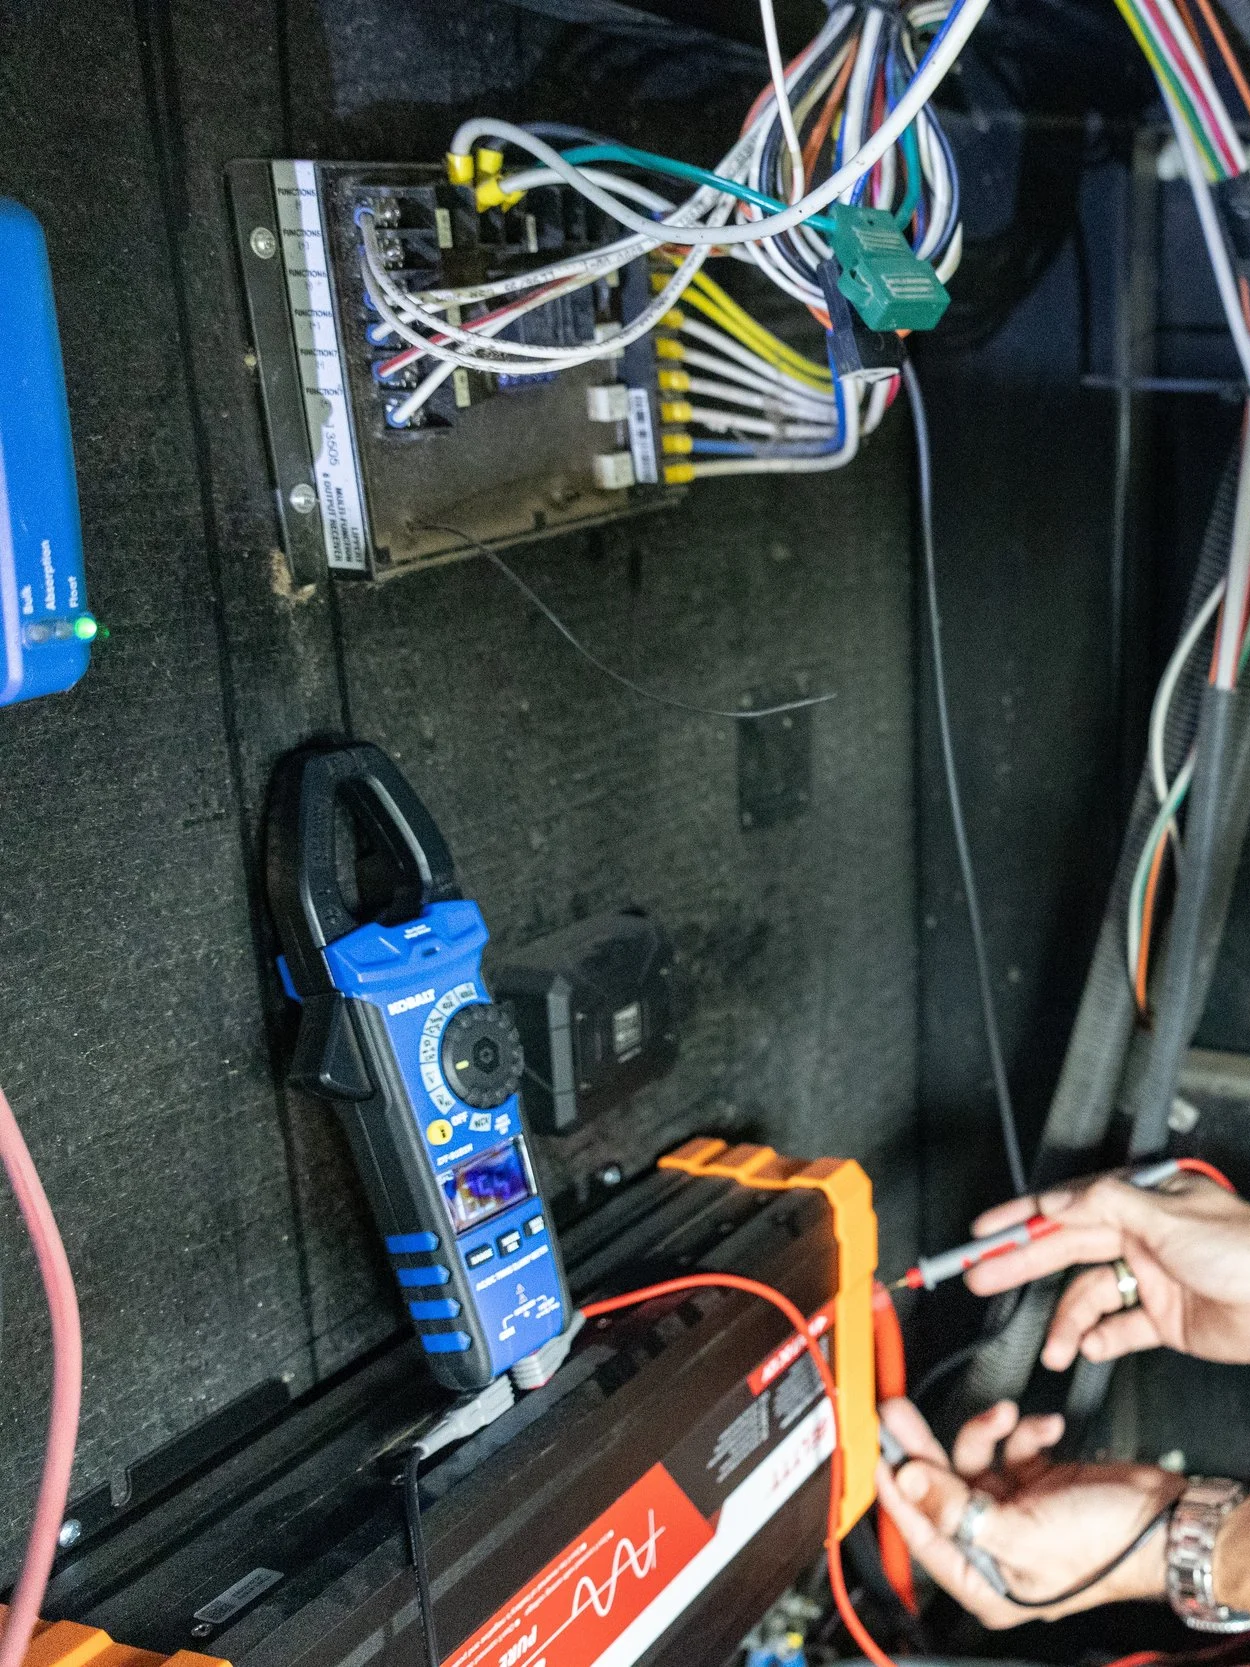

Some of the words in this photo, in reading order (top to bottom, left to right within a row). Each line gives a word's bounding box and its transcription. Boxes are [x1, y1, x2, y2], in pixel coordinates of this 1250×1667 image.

[323, 481, 336, 518] OUTPUT
[329, 519, 342, 562] RECEIVER
[41, 539, 56, 611] Absorption
[67, 575, 79, 608] Float
[387, 987, 436, 1016] KOBALT
